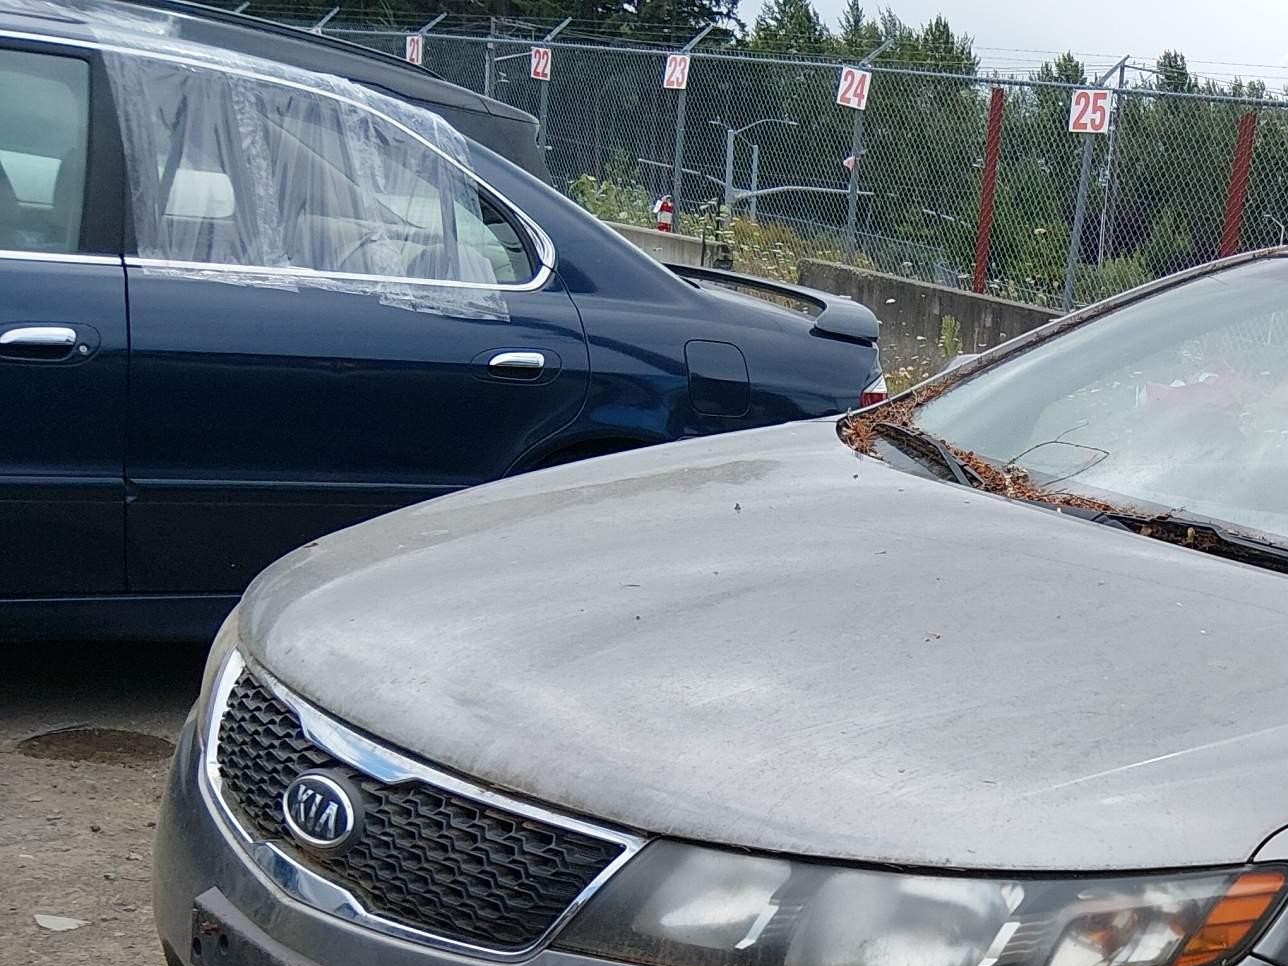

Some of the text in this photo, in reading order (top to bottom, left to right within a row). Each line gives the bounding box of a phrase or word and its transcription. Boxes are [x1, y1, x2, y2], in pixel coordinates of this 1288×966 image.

[409, 38, 419, 63] 21
[533, 49, 549, 79] 22
[666, 57, 688, 88] 23
[840, 70, 867, 107] 24
[1072, 92, 1107, 131] 25
[296, 784, 339, 838] KIA
